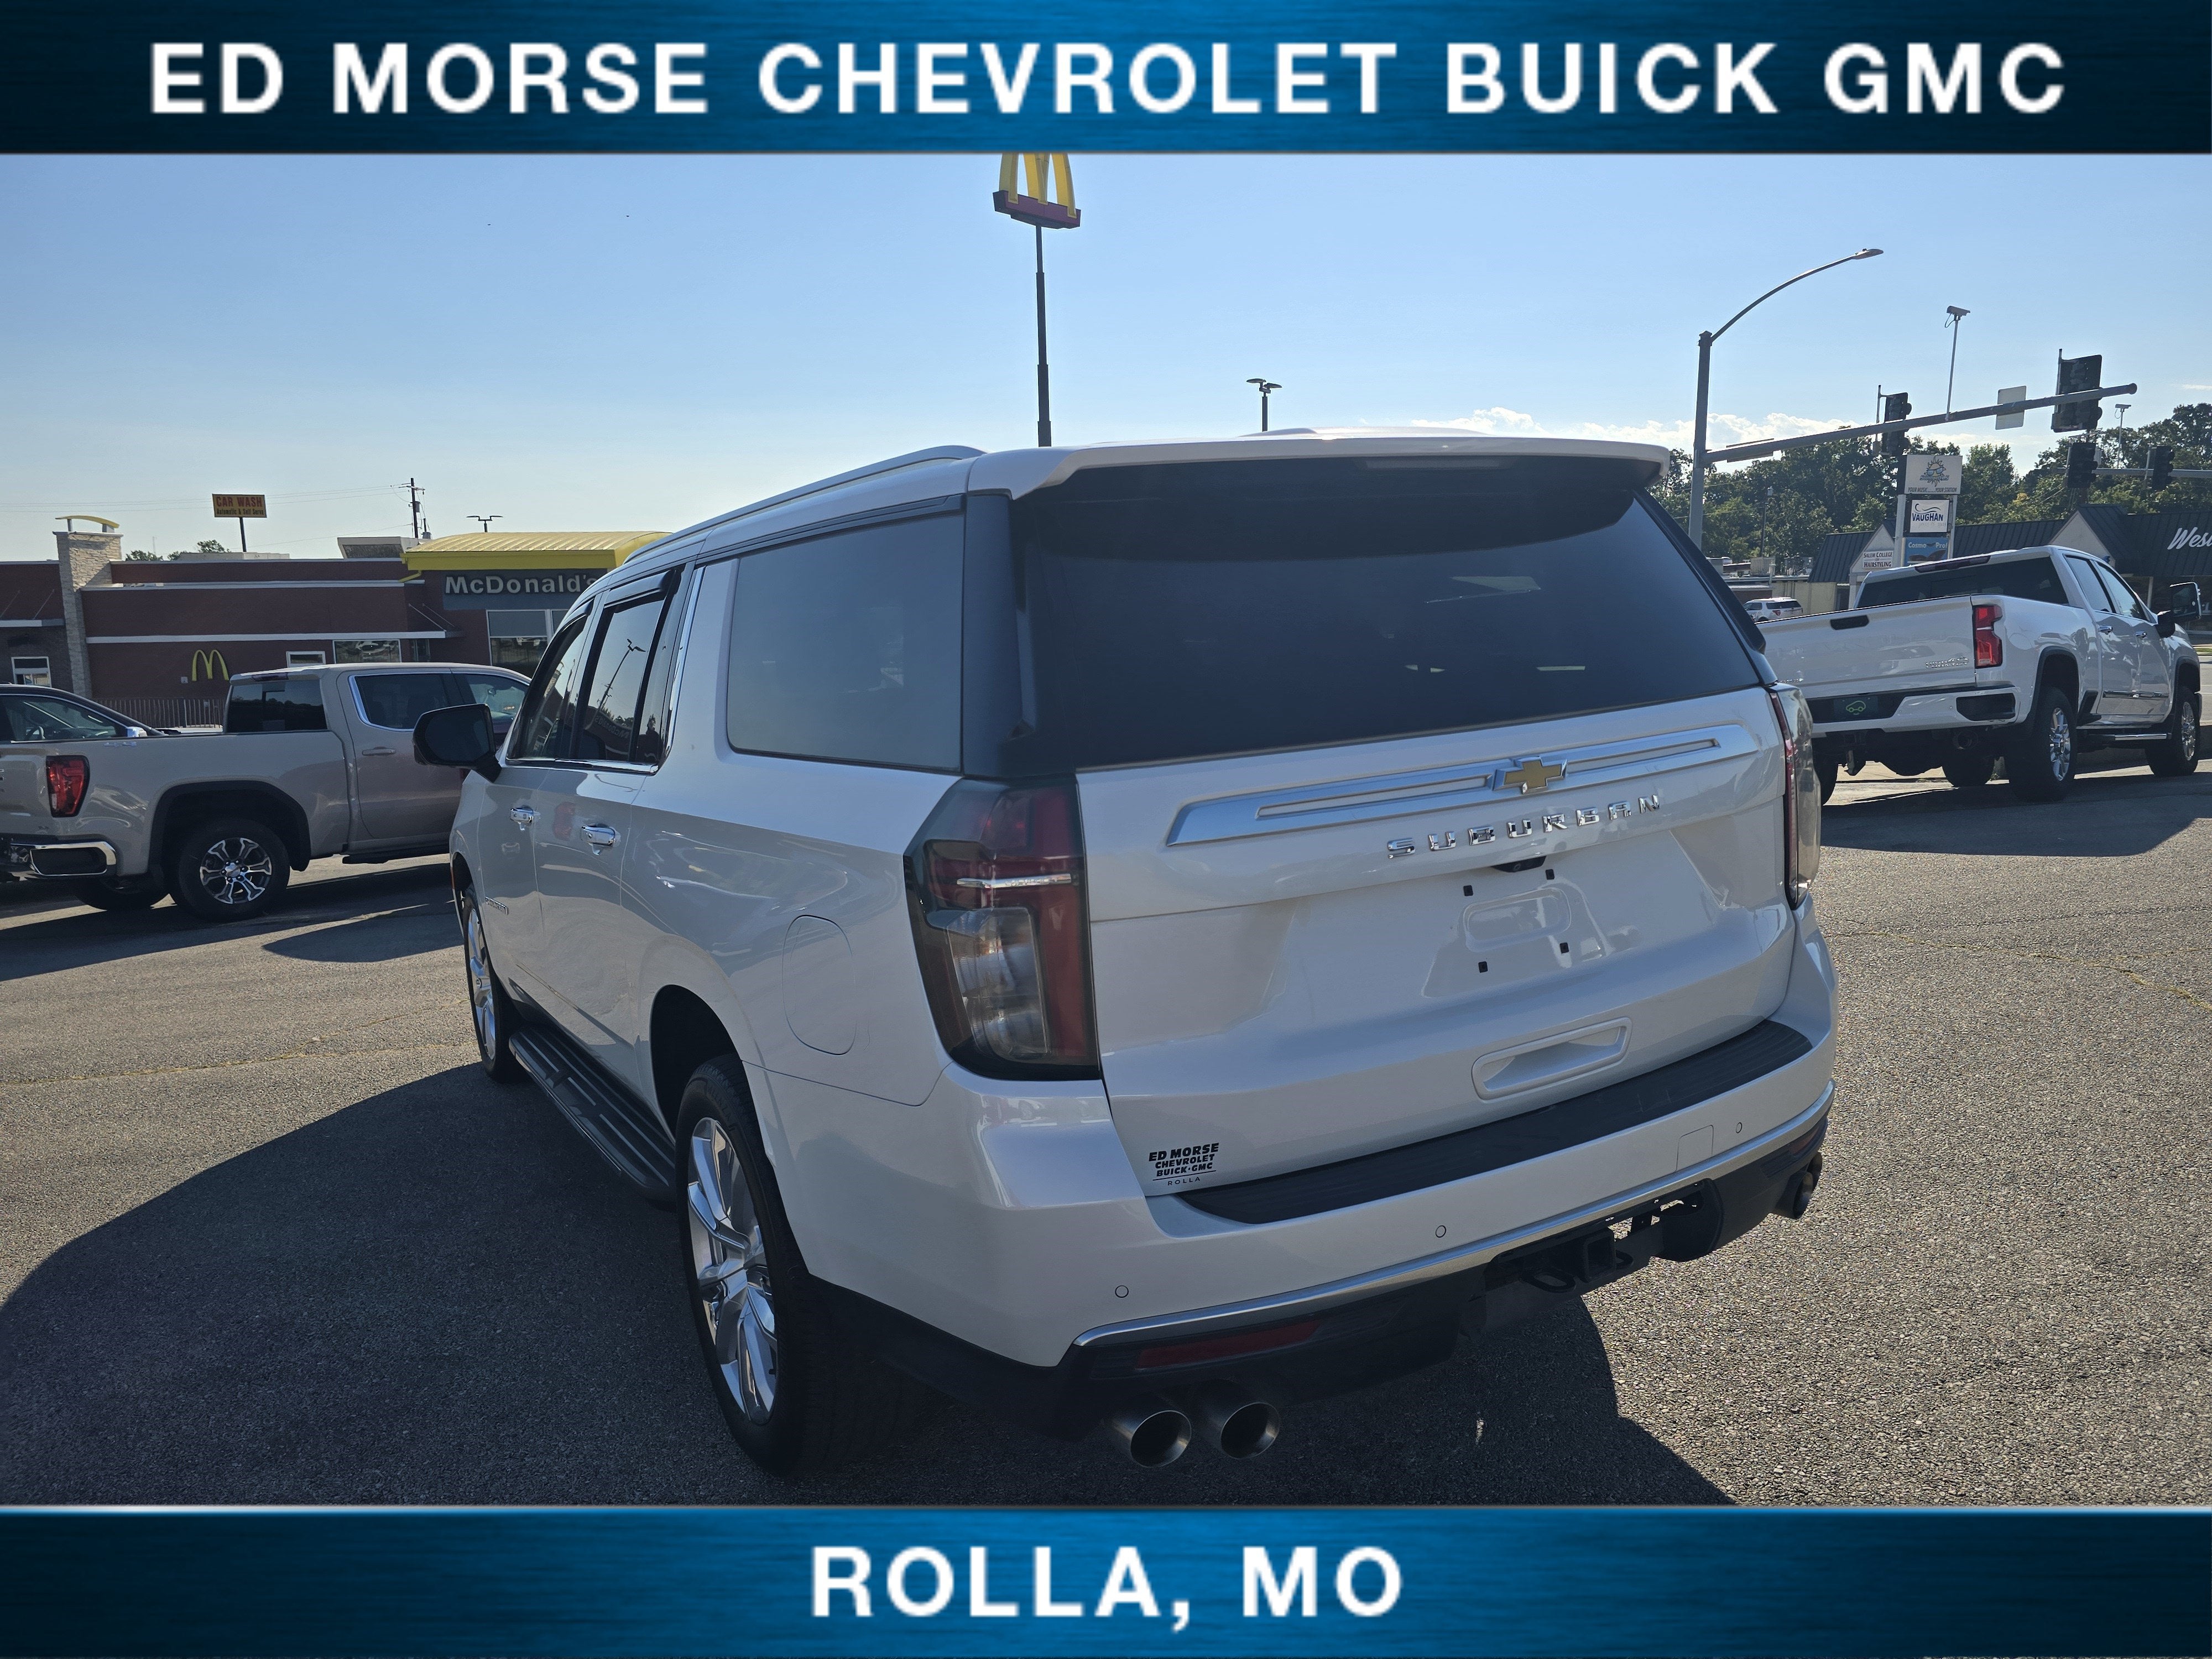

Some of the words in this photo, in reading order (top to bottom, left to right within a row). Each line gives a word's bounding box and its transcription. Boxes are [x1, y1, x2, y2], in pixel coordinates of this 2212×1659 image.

[216, 496, 233, 507] CAR
[237, 497, 263, 507] WASH
[1912, 513, 1944, 521] VAUGHAN
[1387, 794, 1660, 859] SUBURBAN
[1149, 1151, 1167, 1161] ED
[1170, 1142, 1219, 1159] MORSE
[1155, 1154, 1215, 1169] CHEVROLET
[1167, 1177, 1201, 1186] ROLLA
